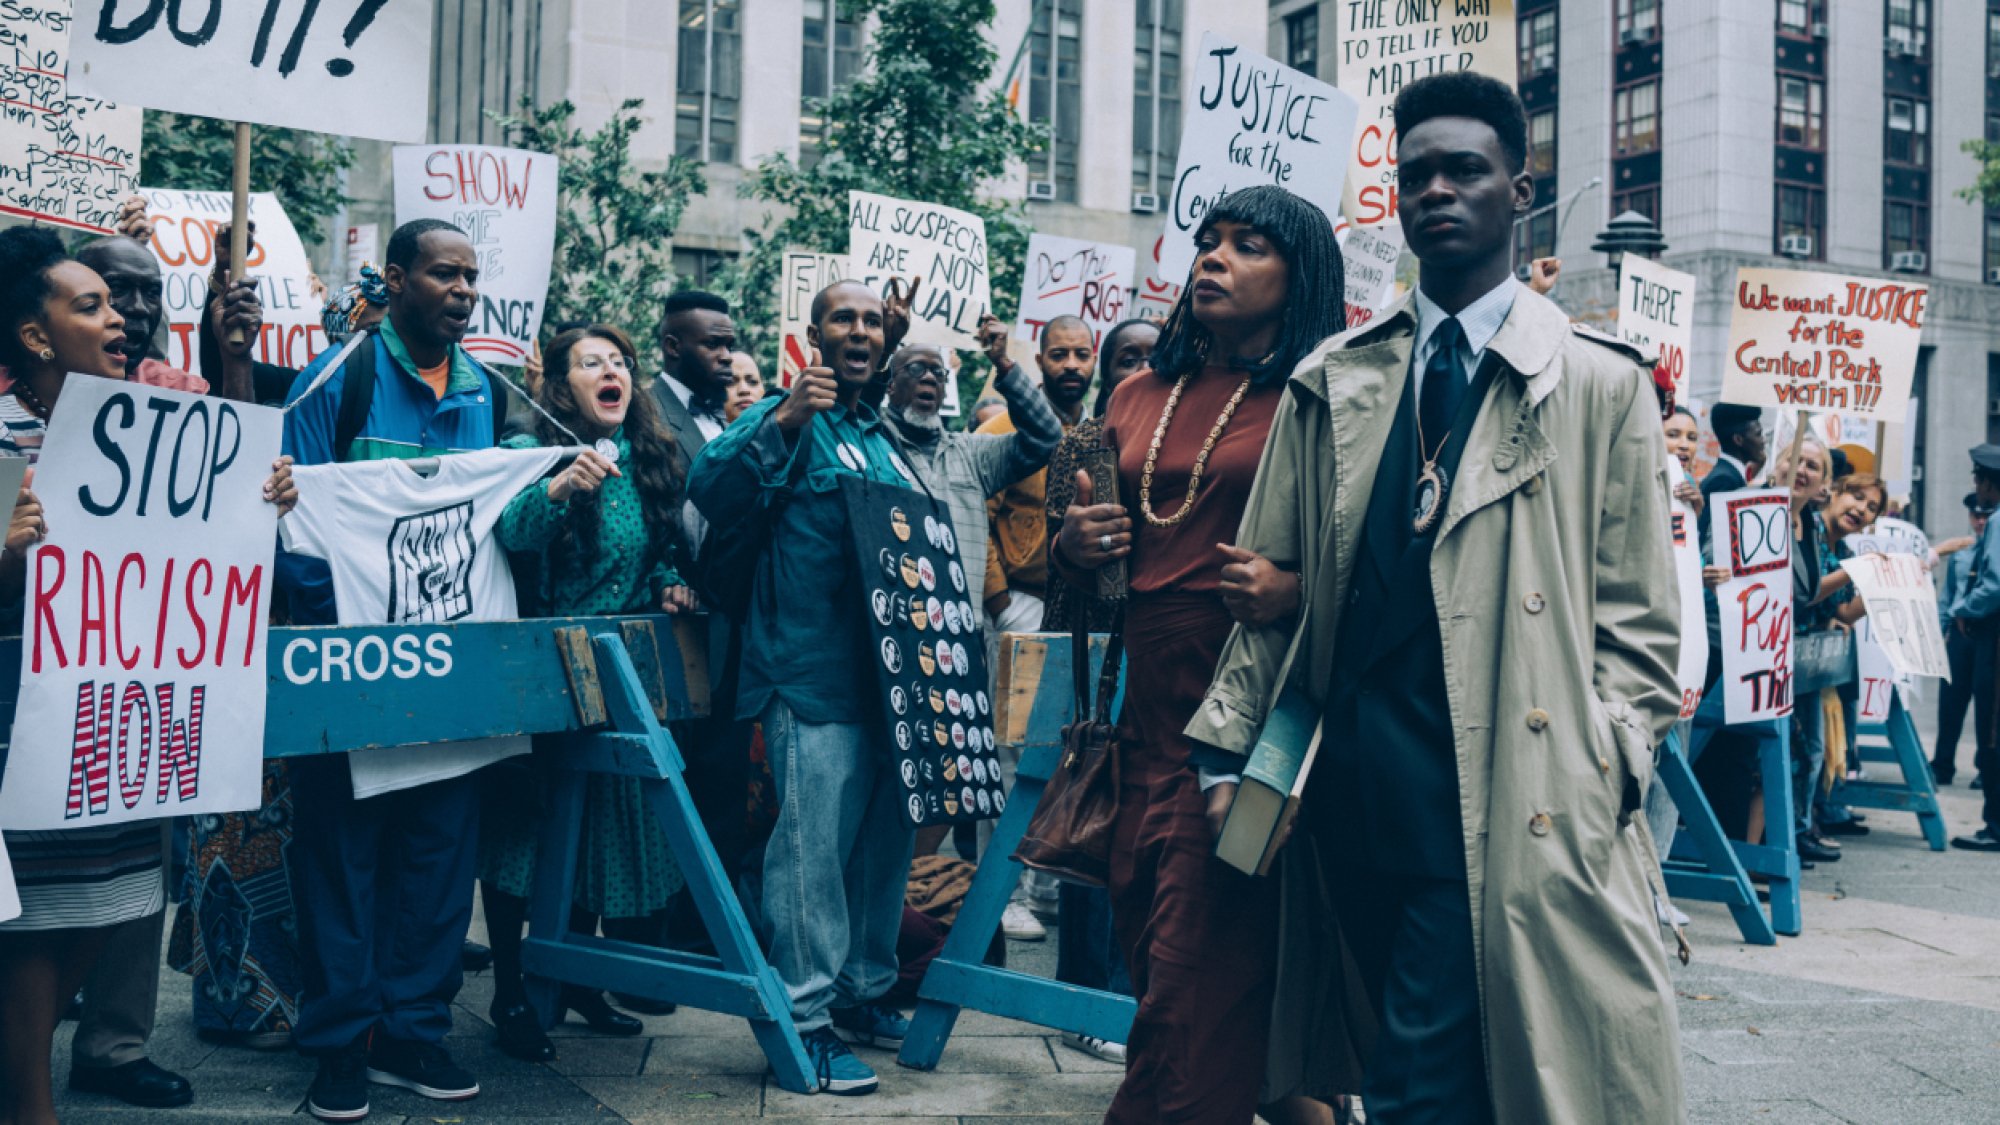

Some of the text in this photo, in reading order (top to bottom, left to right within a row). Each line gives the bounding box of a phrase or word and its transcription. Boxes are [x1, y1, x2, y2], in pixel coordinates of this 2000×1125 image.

[1350, 1, 1387, 31] THE
[1396, 0, 1442, 26] ONLY
[1344, 21, 1489, 64] TO TELL IF YOU
[423, 150, 532, 209] SHOW
[1261, 141, 1292, 184] the
[850, 199, 985, 267] ALL SUSPECTS
[868, 242, 984, 295] ARE NOT
[1630, 275, 1681, 327] THERE
[1739, 280, 1927, 329] We want JUSTICE
[1788, 316, 1864, 349] for the
[1735, 339, 1882, 384] Central Park
[78, 392, 241, 522] STOP
[1739, 505, 1789, 564] DO
[31, 544, 263, 674] RACISM
[282, 632, 454, 685] CROSS
[64, 679, 206, 820] NOW
